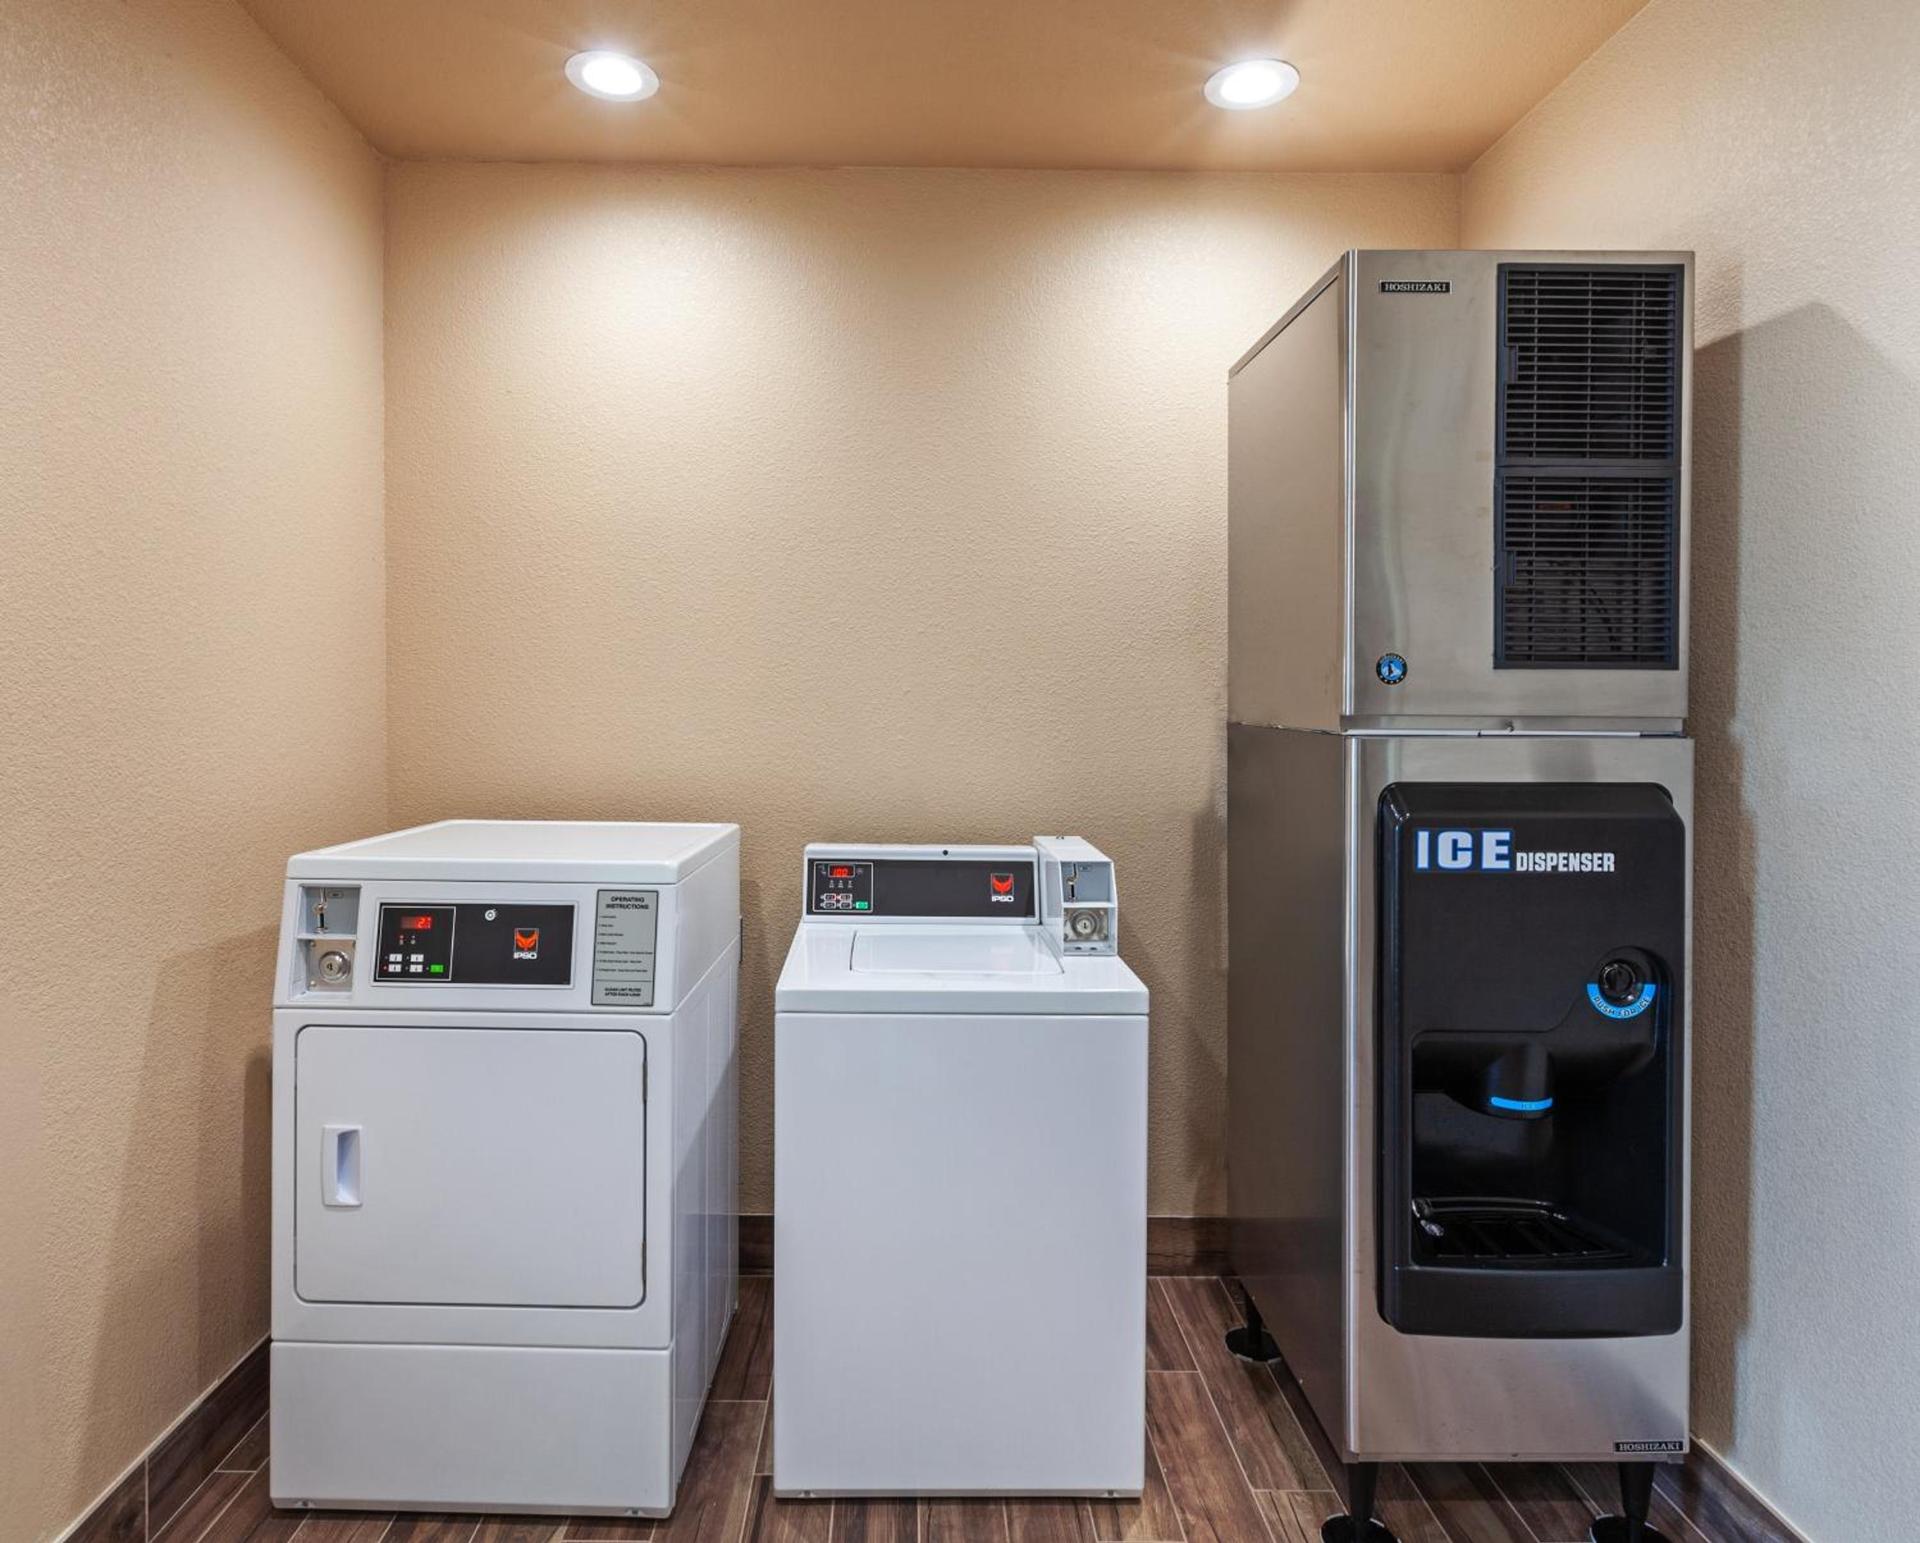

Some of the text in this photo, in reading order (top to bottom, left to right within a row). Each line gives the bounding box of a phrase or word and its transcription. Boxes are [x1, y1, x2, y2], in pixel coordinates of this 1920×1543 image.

[1384, 283, 1447, 292] HOSHIZAKI
[1416, 830, 1615, 873] ICE DISPENSER
[991, 895, 1015, 903] IPSO
[513, 951, 538, 960] IPSO
[1593, 996, 1616, 1015] PUSH
[1618, 1442, 1682, 1452] HOSHIZAKI
